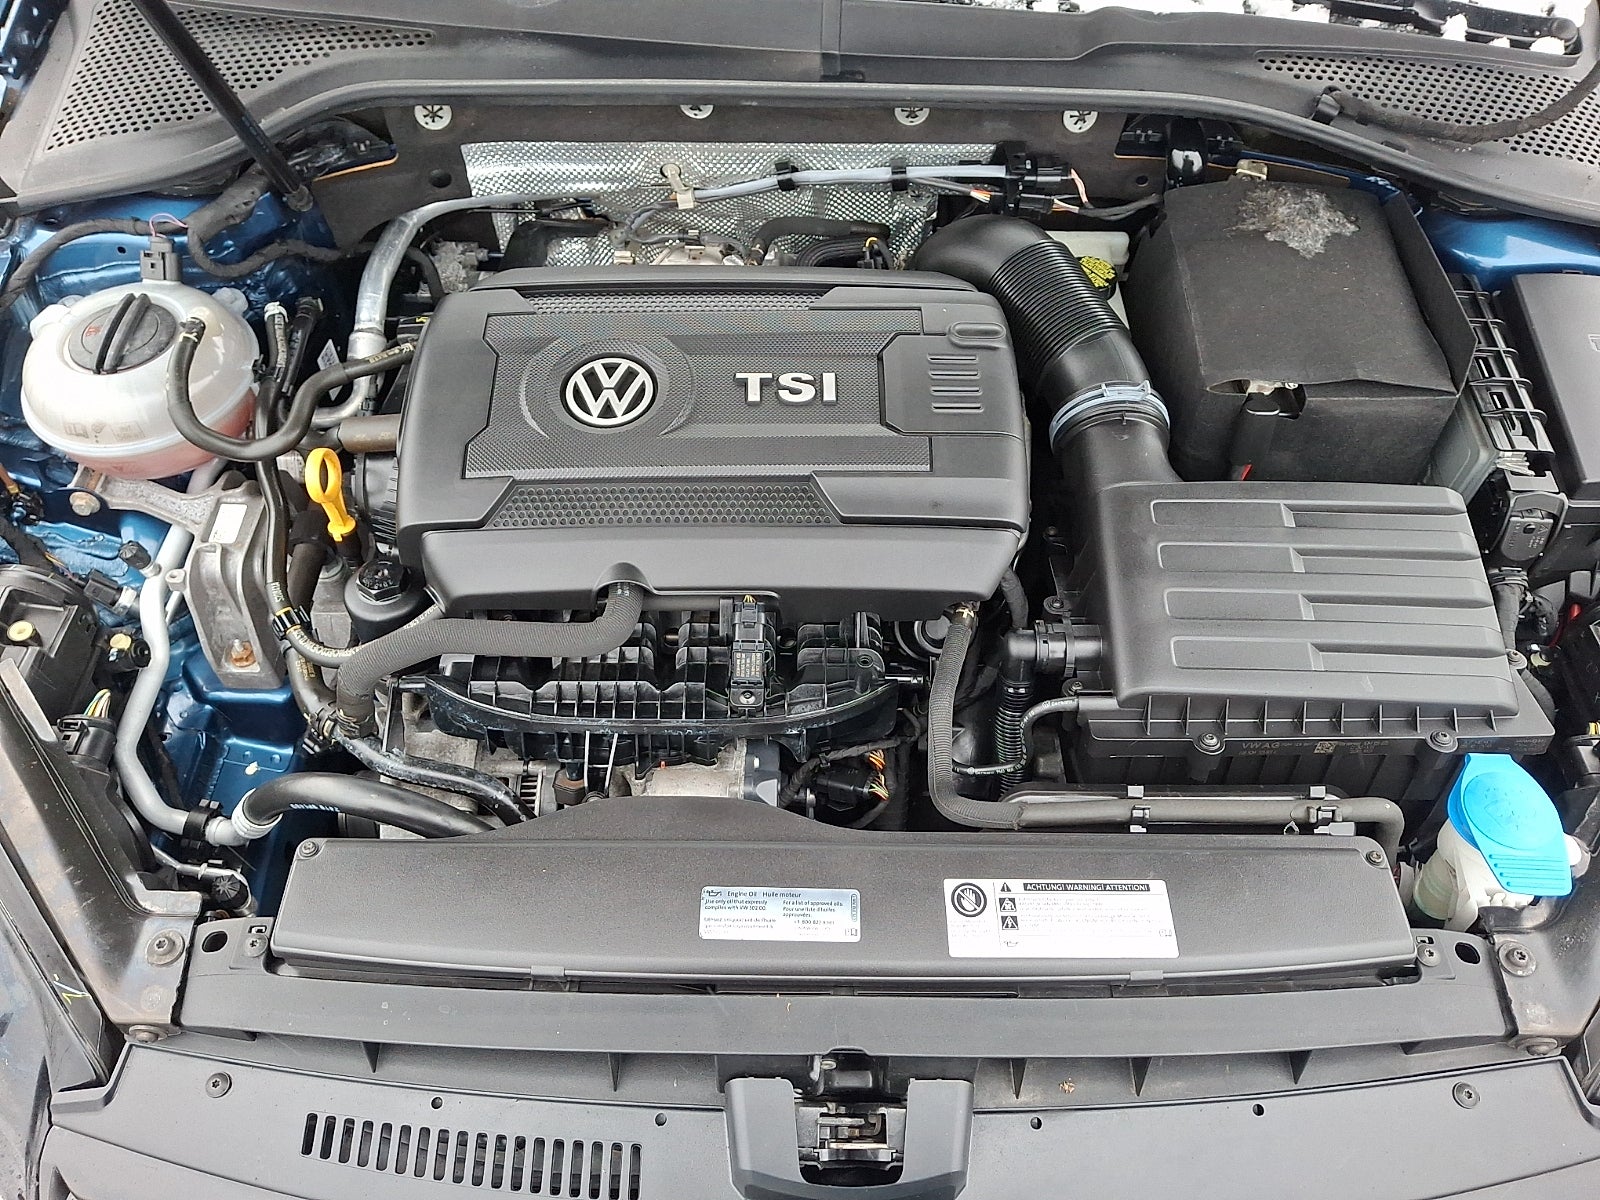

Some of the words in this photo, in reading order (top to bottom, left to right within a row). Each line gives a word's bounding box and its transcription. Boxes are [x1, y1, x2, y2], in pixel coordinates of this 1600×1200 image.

[567, 358, 653, 425] VW
[735, 372, 837, 404] TSI
[727, 890, 748, 898] Engine
[1026, 883, 1065, 891] ACHTUNG!
[1066, 883, 1104, 891] WARNING!
